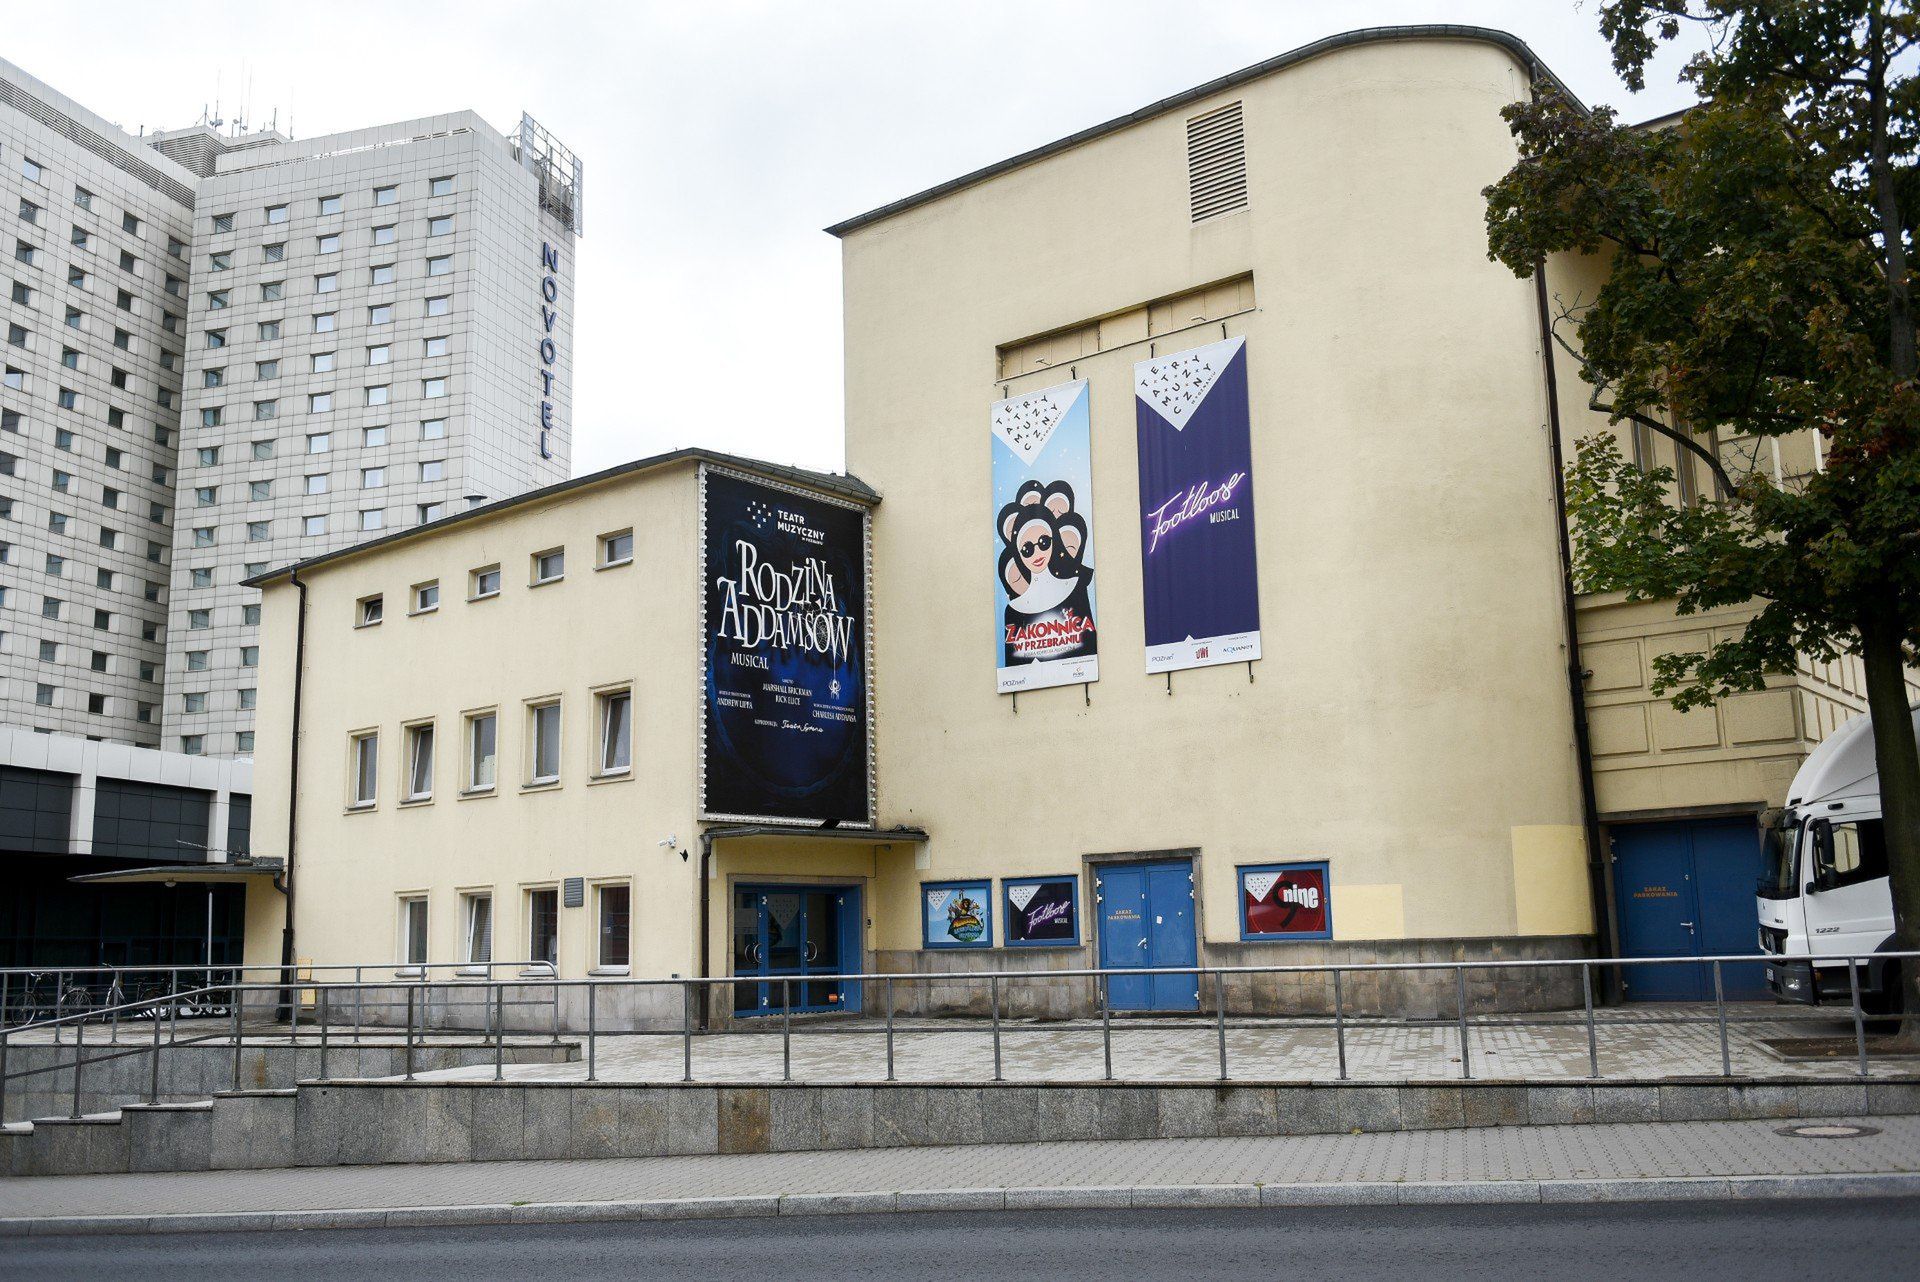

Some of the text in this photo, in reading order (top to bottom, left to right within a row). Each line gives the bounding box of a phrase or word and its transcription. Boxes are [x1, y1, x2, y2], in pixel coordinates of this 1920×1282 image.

[540, 241, 559, 460] NOVOTEL
[777, 510, 805, 525] TEATR
[1148, 472, 1246, 555] Footloose
[1209, 511, 1240, 525] MUSICAL
[777, 521, 825, 541] MUZYCZNY
[736, 539, 839, 613] RODZINA
[1005, 612, 1097, 644] ZAKONNICA
[1014, 643, 1024, 652] W
[1024, 634, 1082, 652] PRZEBRANIU
[730, 652, 770, 670] MUSICAL
[1283, 884, 1319, 909] nine
[1027, 901, 1071, 934] Footloose
[1815, 926, 1840, 934] 1222
